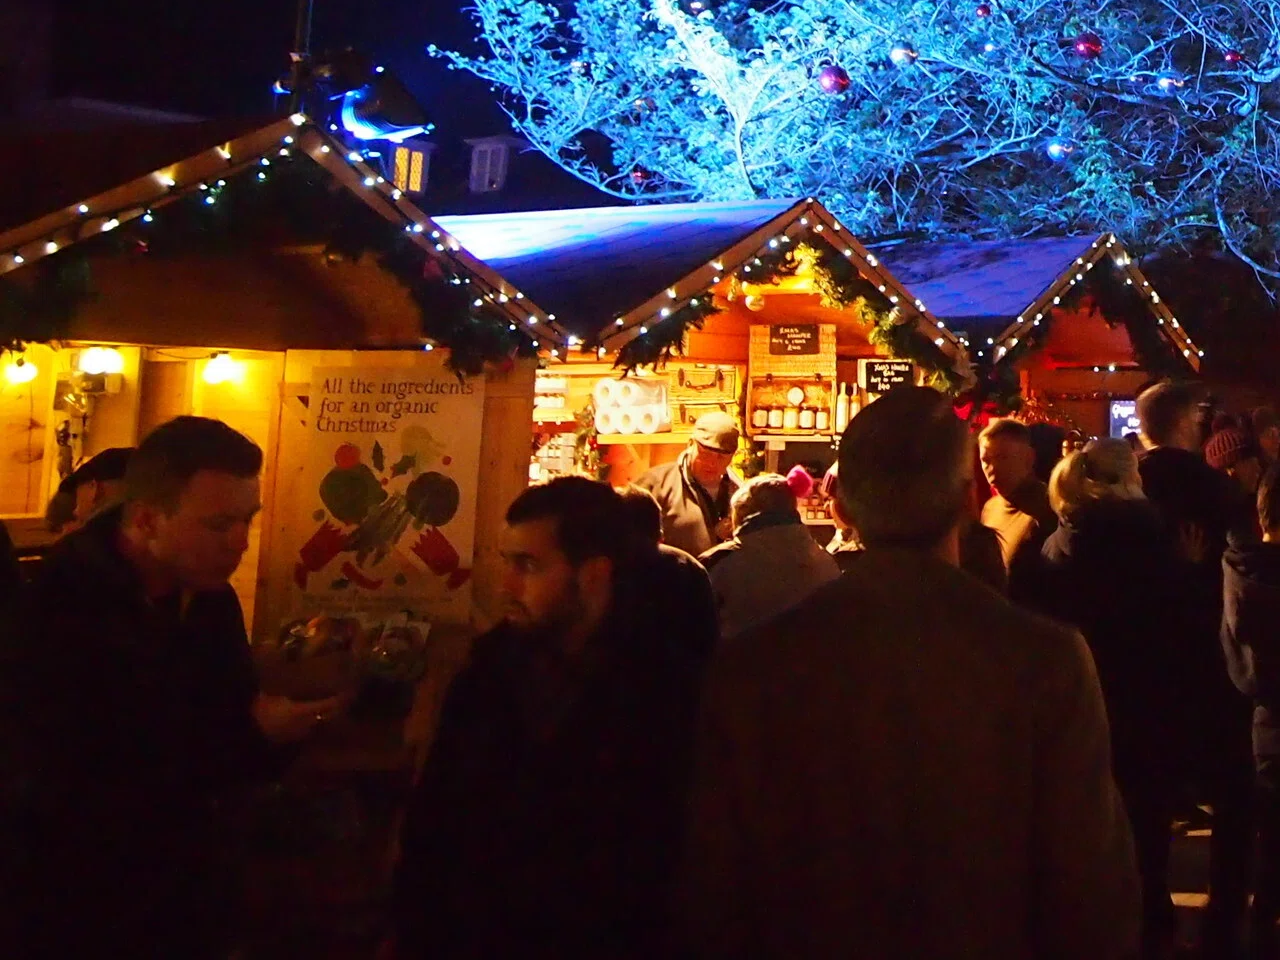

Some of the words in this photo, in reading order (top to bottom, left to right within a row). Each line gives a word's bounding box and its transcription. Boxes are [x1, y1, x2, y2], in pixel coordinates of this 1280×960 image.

[321, 377, 343, 394] All
[349, 378, 376, 394] the
[380, 378, 474, 400] ingredients
[317, 397, 344, 418] for
[350, 400, 370, 413] an
[375, 400, 439, 419] organic
[316, 415, 397, 432] Christmas
